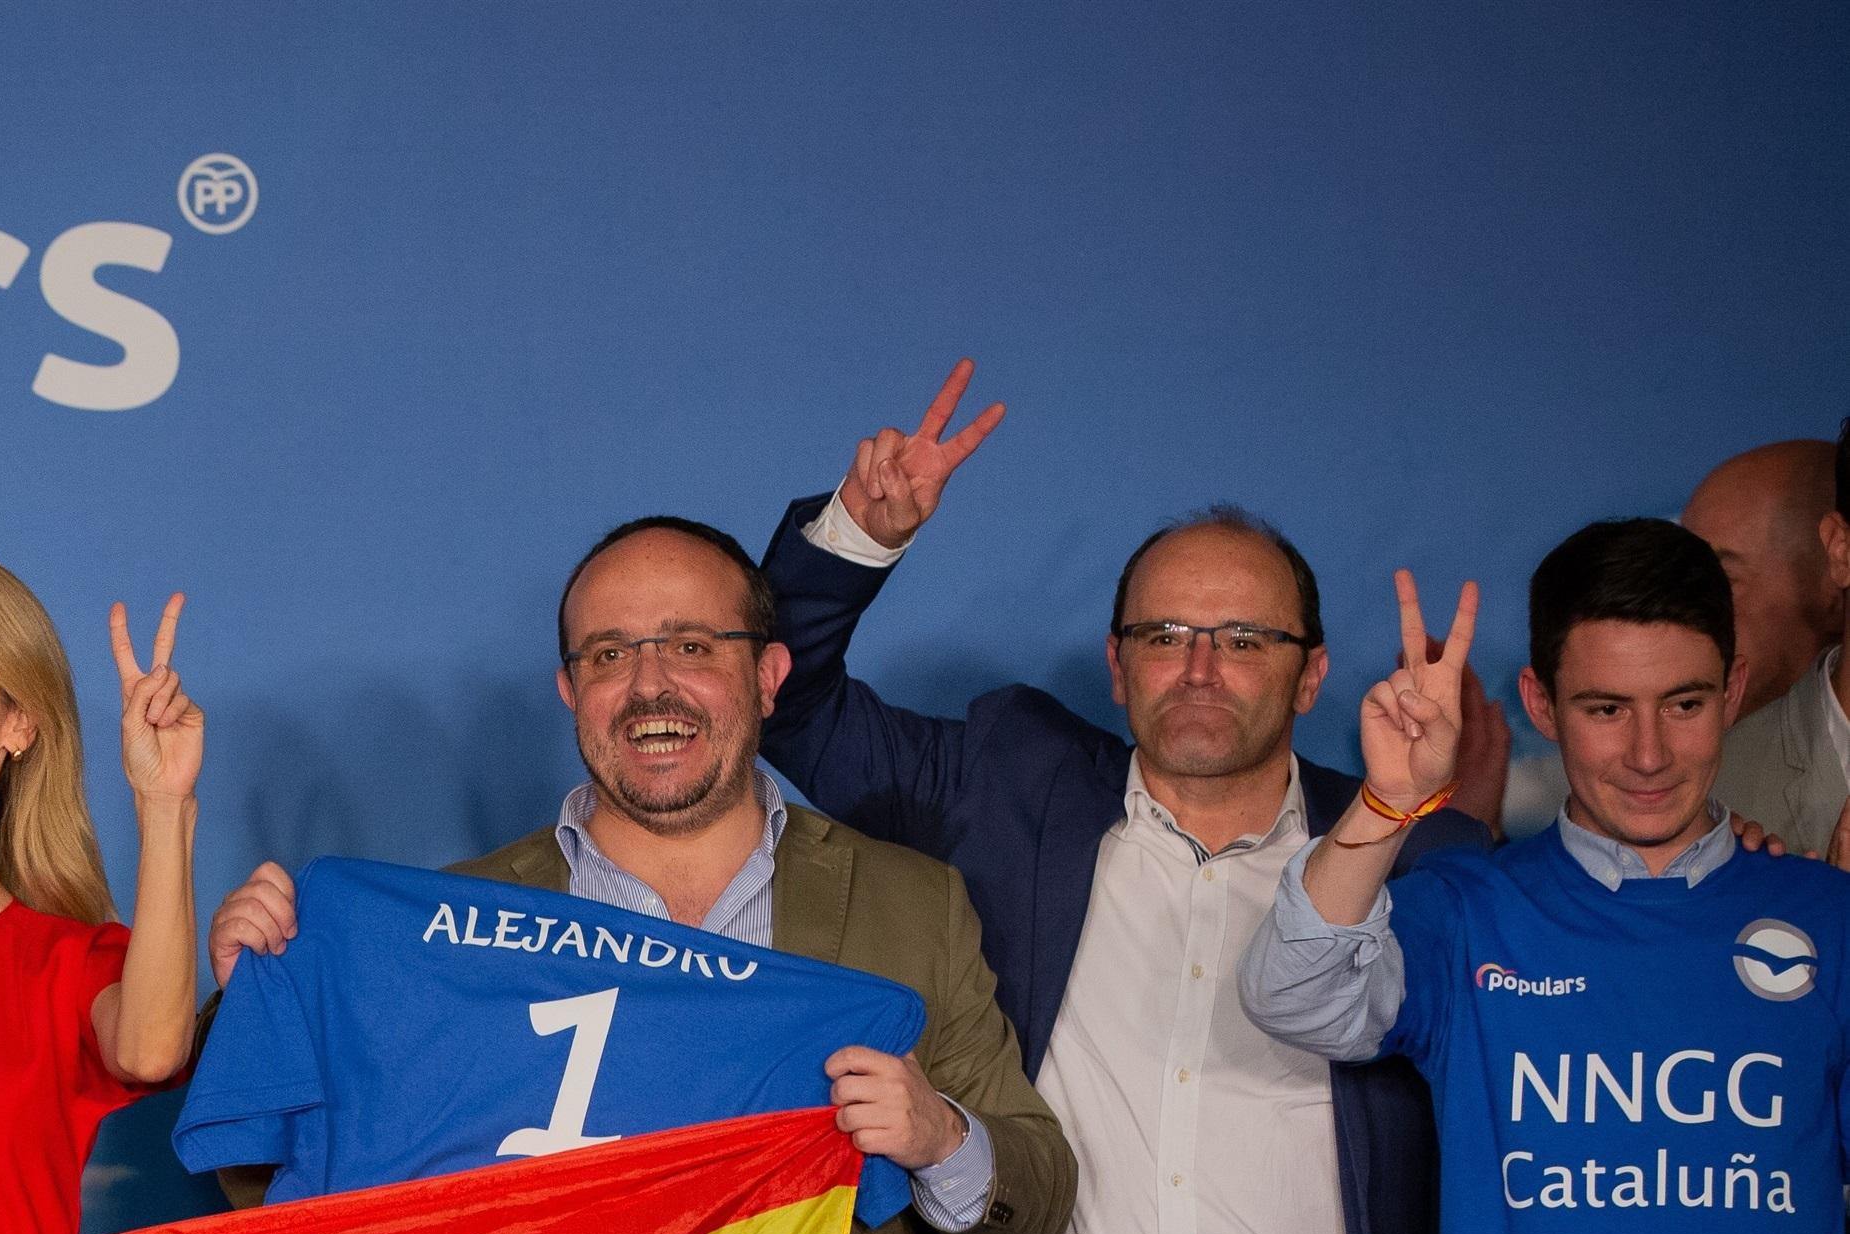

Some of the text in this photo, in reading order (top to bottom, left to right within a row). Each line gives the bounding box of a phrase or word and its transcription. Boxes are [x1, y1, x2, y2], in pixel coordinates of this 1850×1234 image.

[1488, 972, 1586, 996] populars
[495, 987, 622, 1157] 1
[1511, 1049, 1783, 1127] NNGG
[1502, 1148, 1796, 1214] Cataluña
